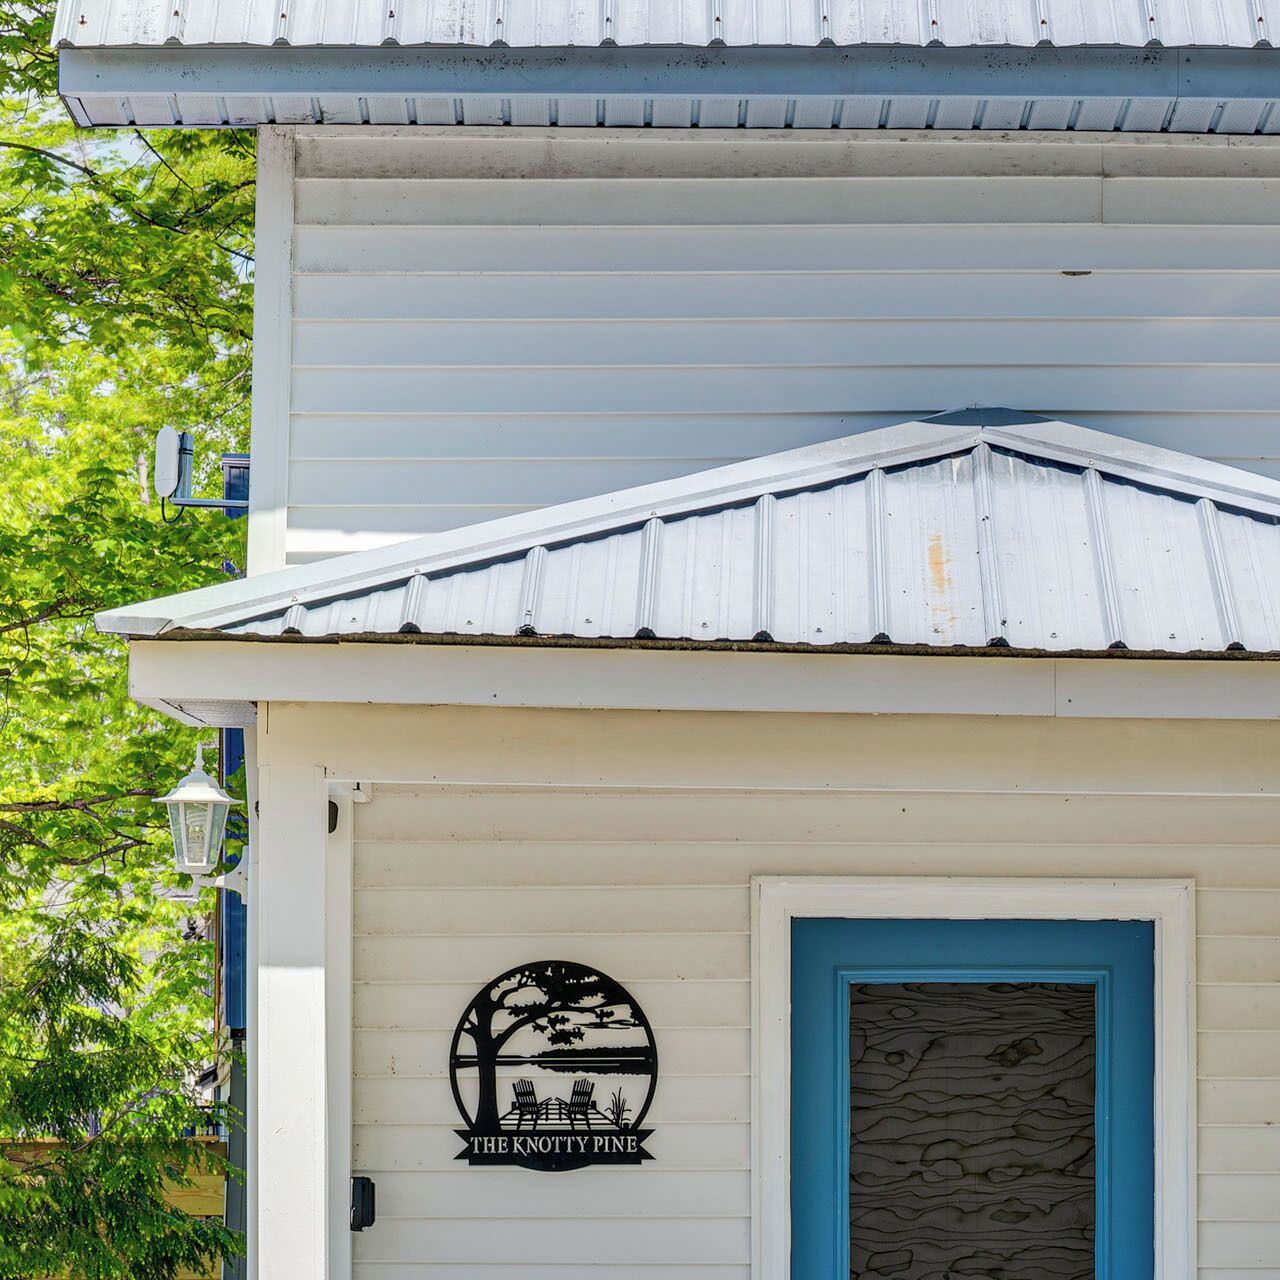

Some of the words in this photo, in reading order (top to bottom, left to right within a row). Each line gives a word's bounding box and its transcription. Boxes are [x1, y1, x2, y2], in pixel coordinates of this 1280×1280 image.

[470, 1136, 509, 1154] THE
[512, 1136, 589, 1157] KNOTTY
[592, 1135, 638, 1153] PINE
